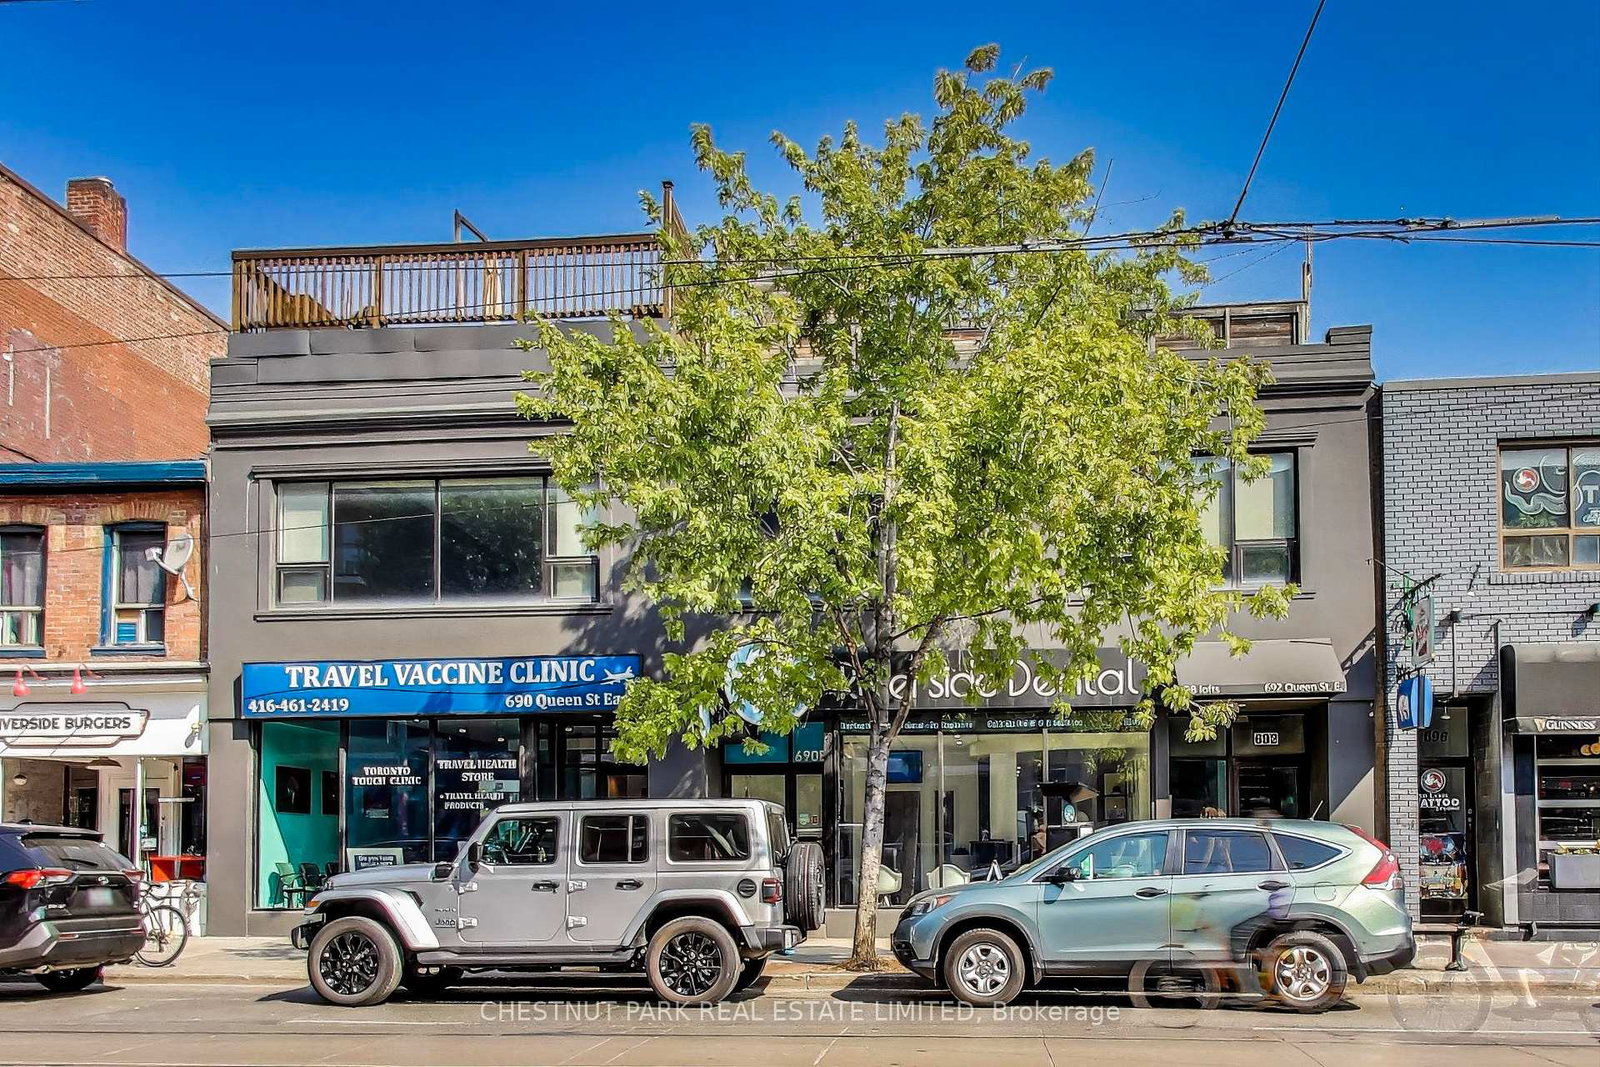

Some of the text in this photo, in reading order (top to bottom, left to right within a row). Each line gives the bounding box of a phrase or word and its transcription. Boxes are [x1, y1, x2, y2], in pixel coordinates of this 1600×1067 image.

[285, 659, 596, 688] TRAVEL VACCINE CLINIC
[1285, 682, 1317, 693] Queen
[248, 697, 350, 713] 416-461-2419
[505, 692, 622, 710] 690 Queen St Ea
[64, 716, 132, 730] BURGERS
[437, 759, 517, 770] TRAVEL HEALTH
[363, 766, 411, 776] TORONTO
[461, 772, 495, 782] STORE
